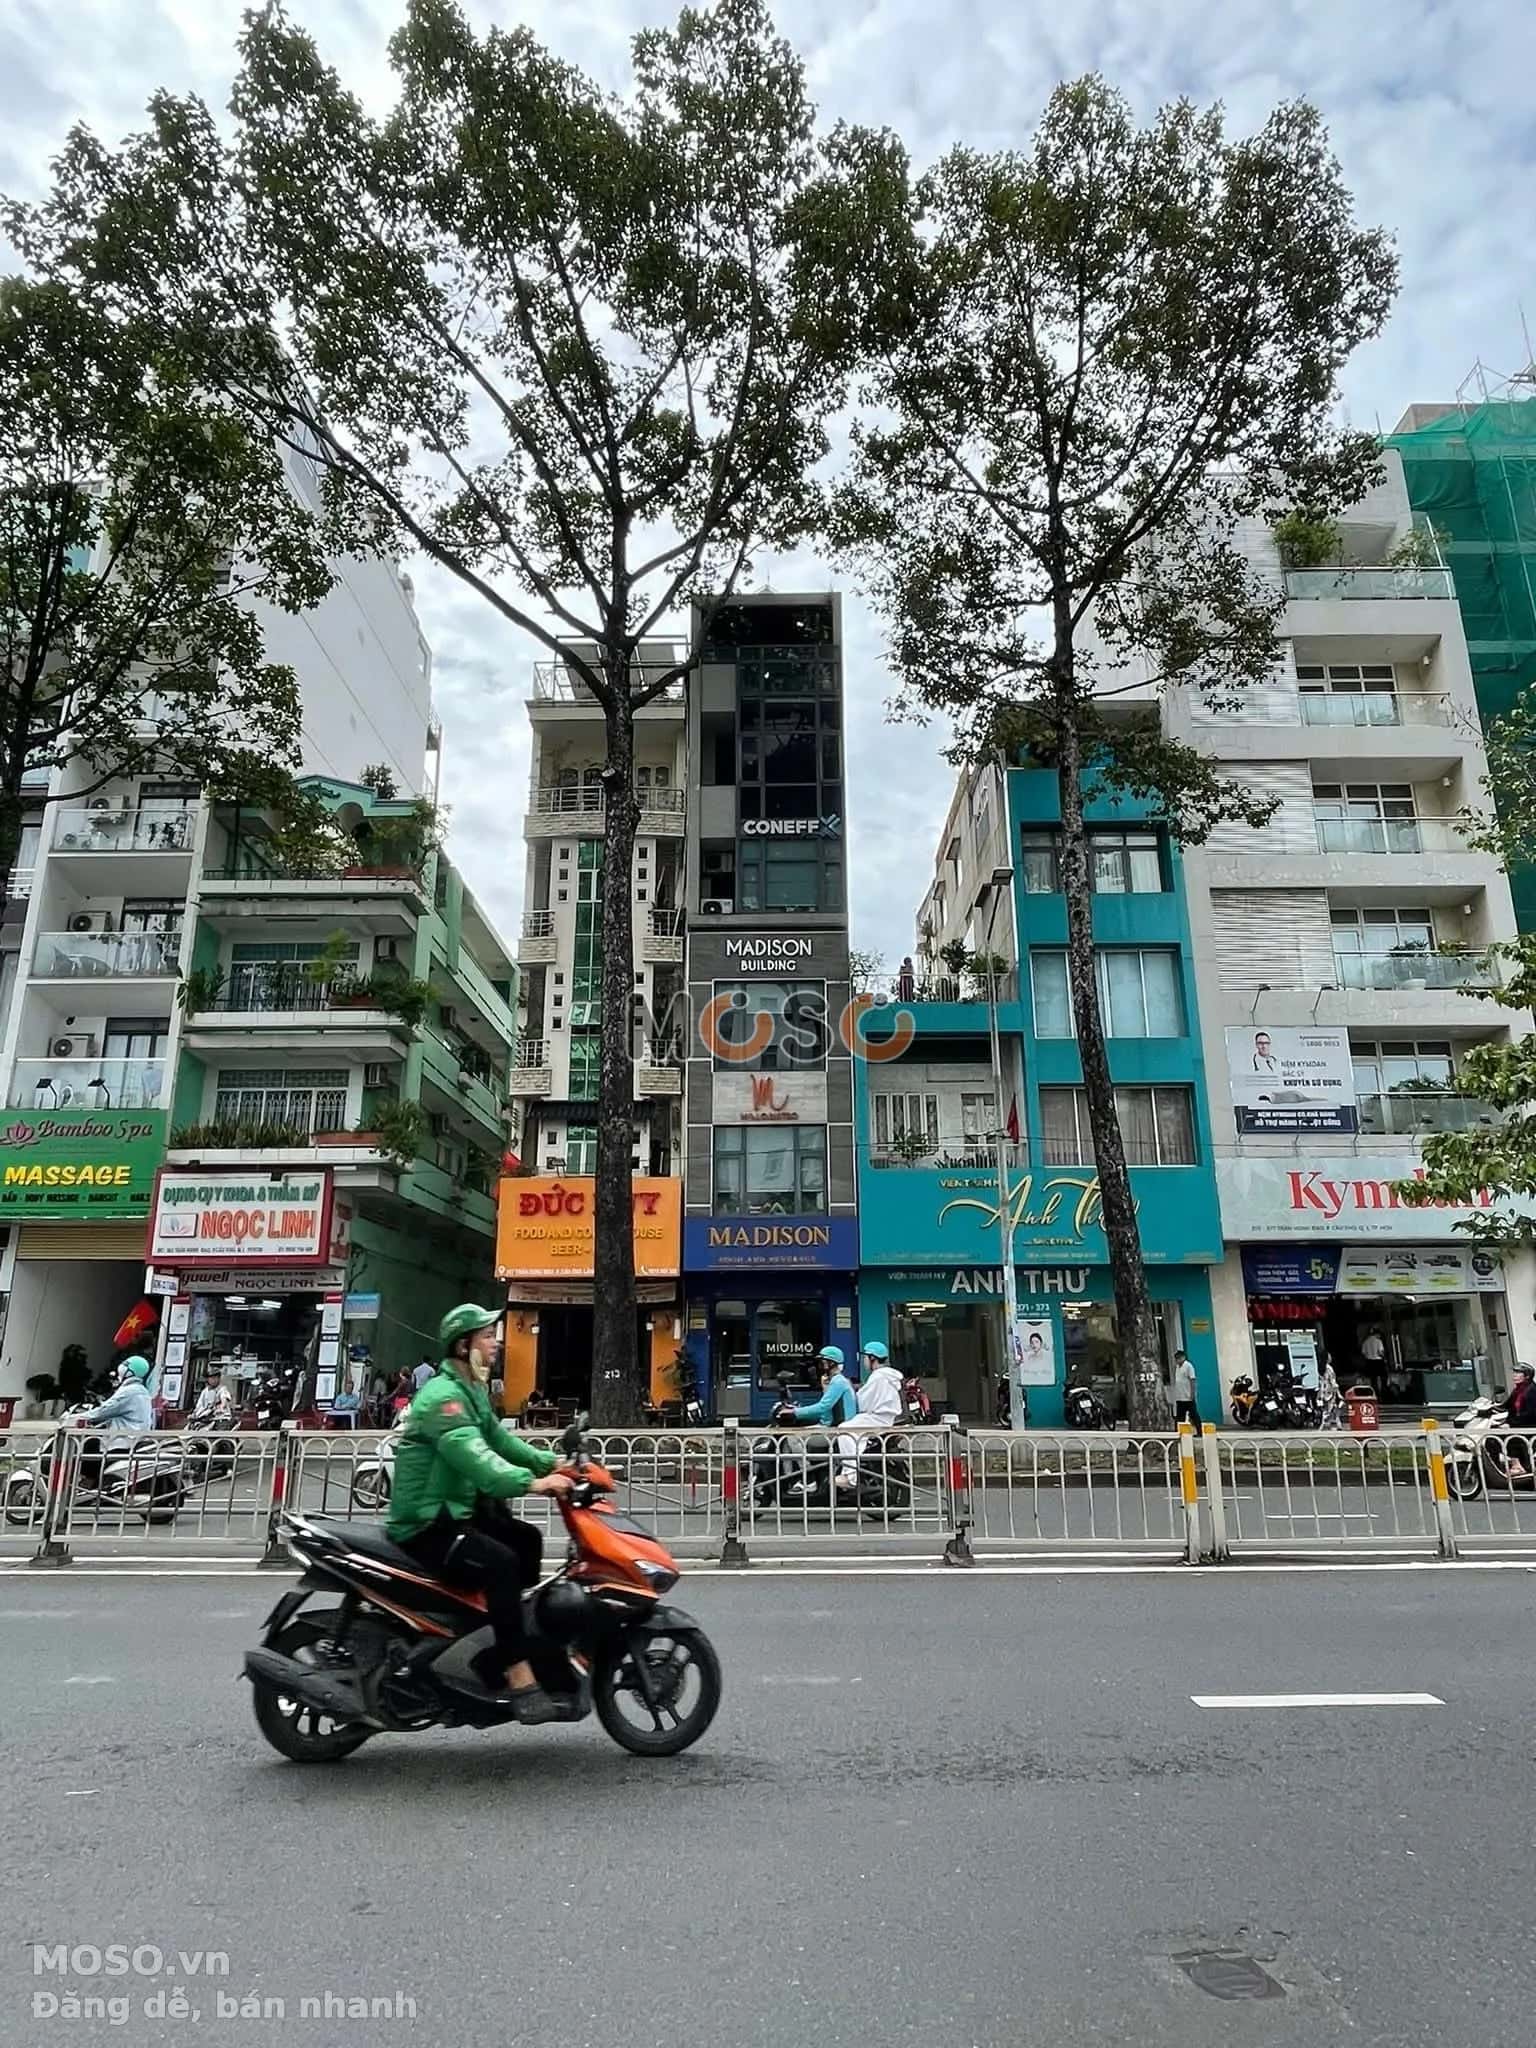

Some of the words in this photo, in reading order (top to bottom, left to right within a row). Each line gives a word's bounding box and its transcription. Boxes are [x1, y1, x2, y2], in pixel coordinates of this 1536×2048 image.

[726, 938, 812, 957] MADISON
[740, 959, 797, 972] BUILDING
[38, 1116, 113, 1138] Bamboo
[114, 1119, 154, 1143] Spa
[4, 1165, 132, 1186] MASSAGE
[519, 1183, 585, 1217] ĐỨC
[201, 1210, 265, 1245] NGỌC
[268, 1210, 318, 1239] LINH
[514, 1226, 546, 1240] FOOD
[547, 1226, 572, 1240] AND
[708, 1226, 832, 1247] MADISON
[235, 1279, 277, 1290] NGỌC
[281, 1279, 315, 1288] LINH
[1024, 1268, 1092, 1294] THƯ
